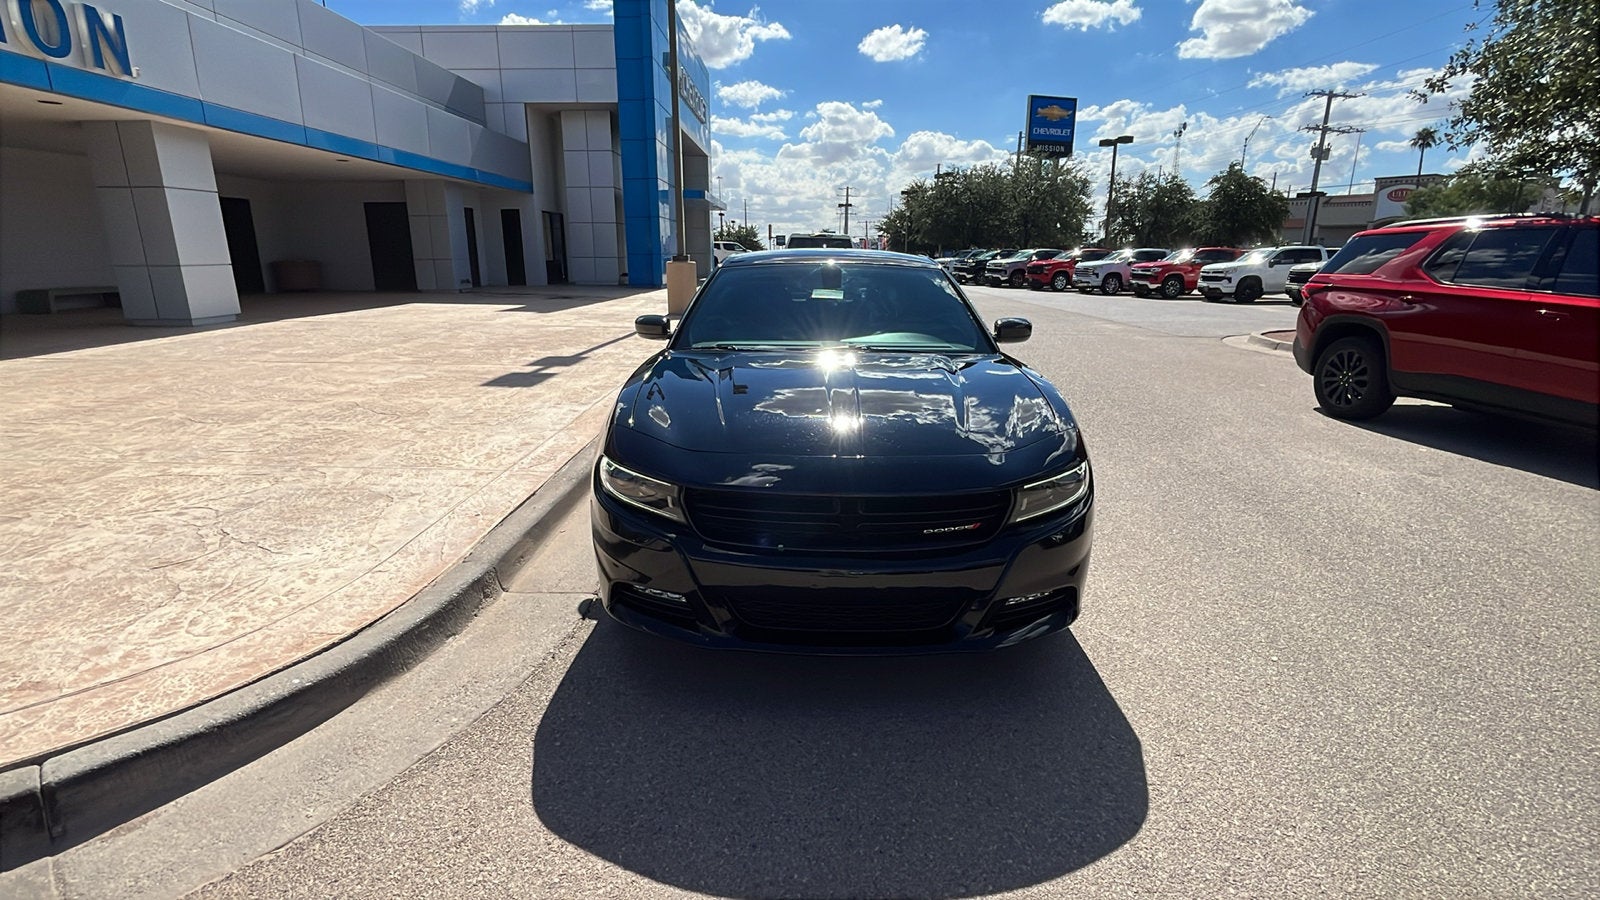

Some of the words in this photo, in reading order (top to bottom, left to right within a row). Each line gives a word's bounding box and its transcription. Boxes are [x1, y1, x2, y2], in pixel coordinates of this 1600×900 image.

[1033, 127, 1071, 136] CHEVROLET
[1036, 144, 1065, 152] MISSION
[923, 524, 974, 534] DODGE
